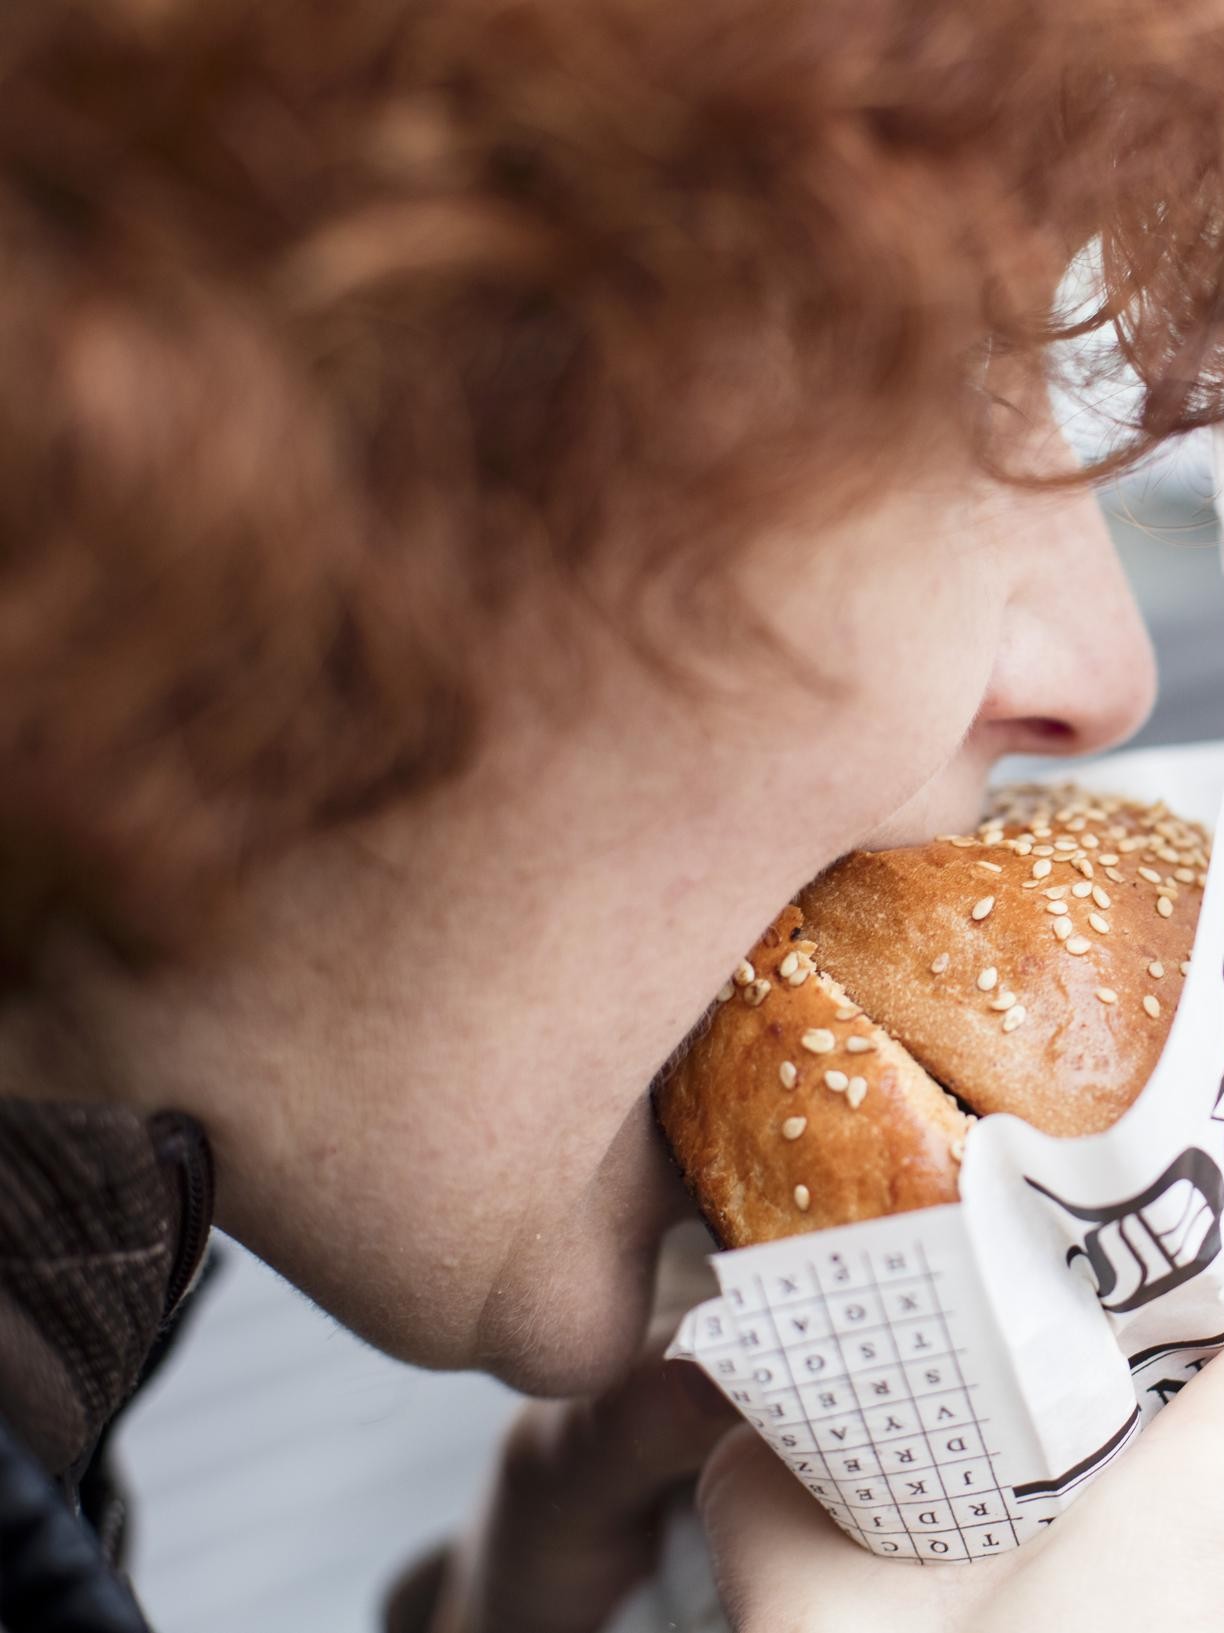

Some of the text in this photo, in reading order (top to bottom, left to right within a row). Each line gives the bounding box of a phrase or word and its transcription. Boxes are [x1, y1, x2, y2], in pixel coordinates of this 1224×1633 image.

[915, 1332, 931, 1349] T
[860, 1343, 877, 1360] S
[925, 1369, 941, 1385] S
[871, 1381, 891, 1396] R
[782, 1406, 955, 1448] V Y A S
[946, 1437, 968, 1453] D
[895, 1448, 917, 1464] R
[843, 1458, 862, 1473] E
[963, 1471, 975, 1487] J
[856, 1488, 875, 1502] E
[906, 1480, 929, 1496] K
[918, 1511, 940, 1526] D
[968, 1503, 992, 1518] R
[880, 1533, 1001, 1555] T Q C
